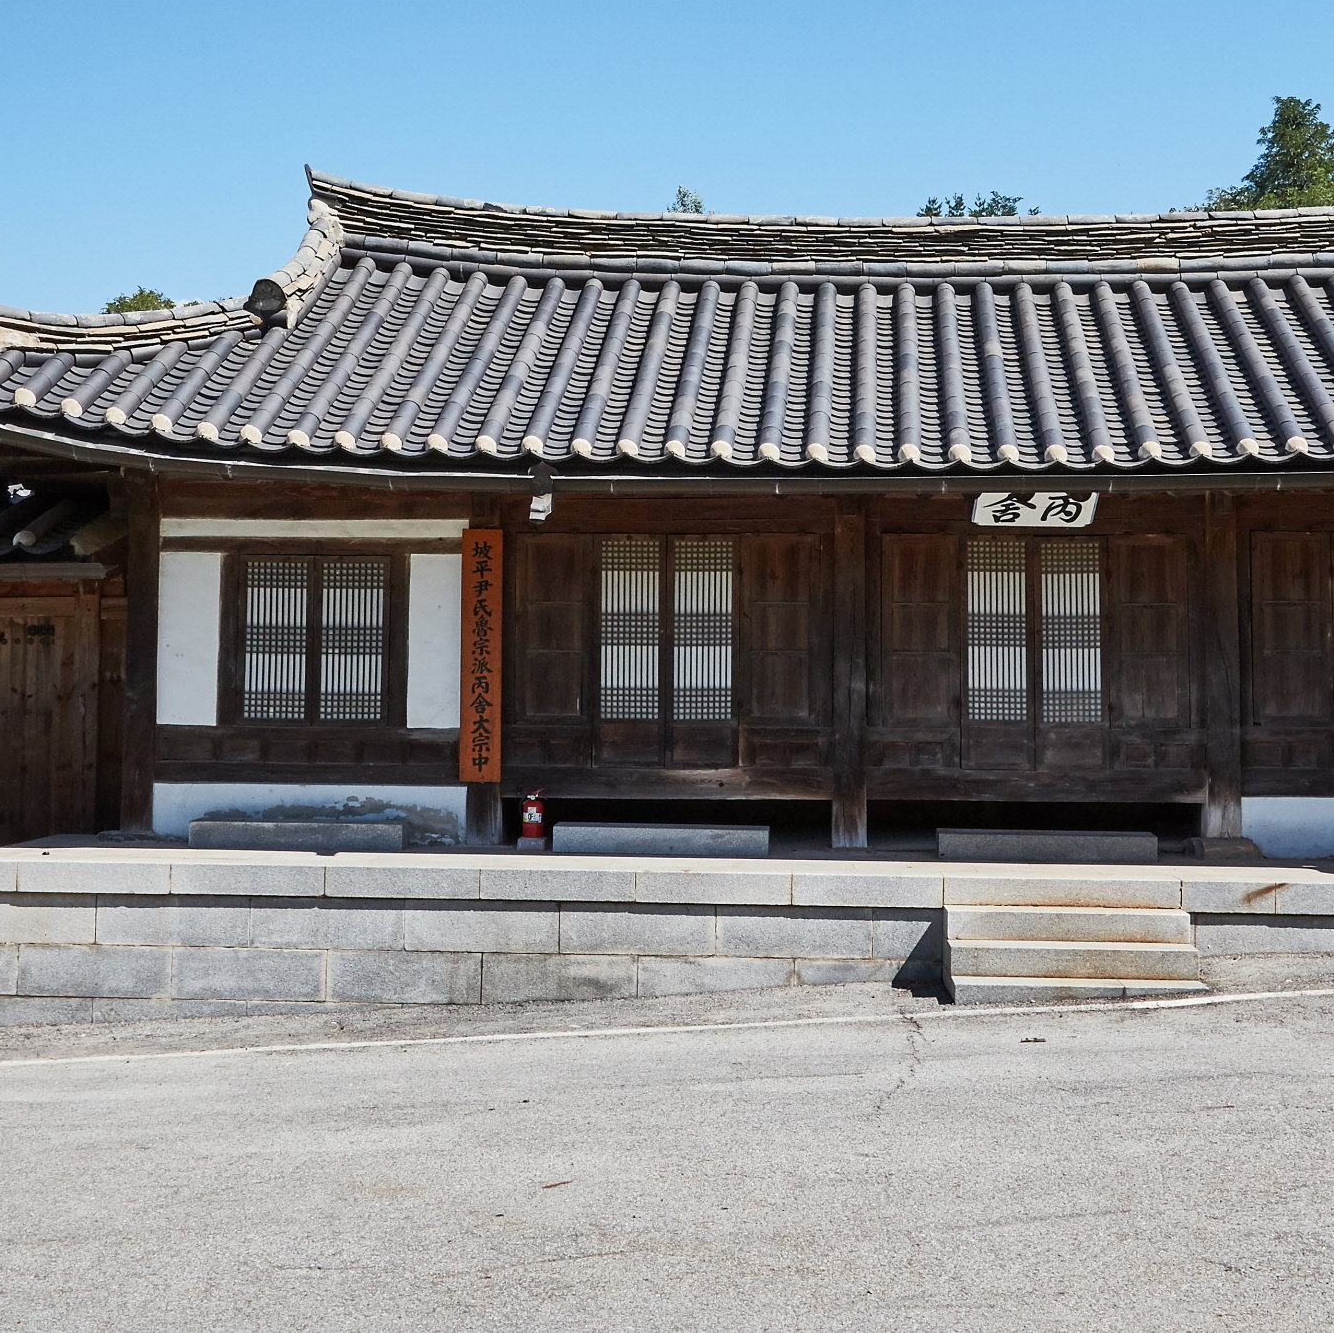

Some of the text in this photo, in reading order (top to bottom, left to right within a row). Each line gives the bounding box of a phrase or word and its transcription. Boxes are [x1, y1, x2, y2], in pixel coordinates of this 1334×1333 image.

[470, 541, 494, 773] 坡平尹氏魯宗派丙舍大宗中
